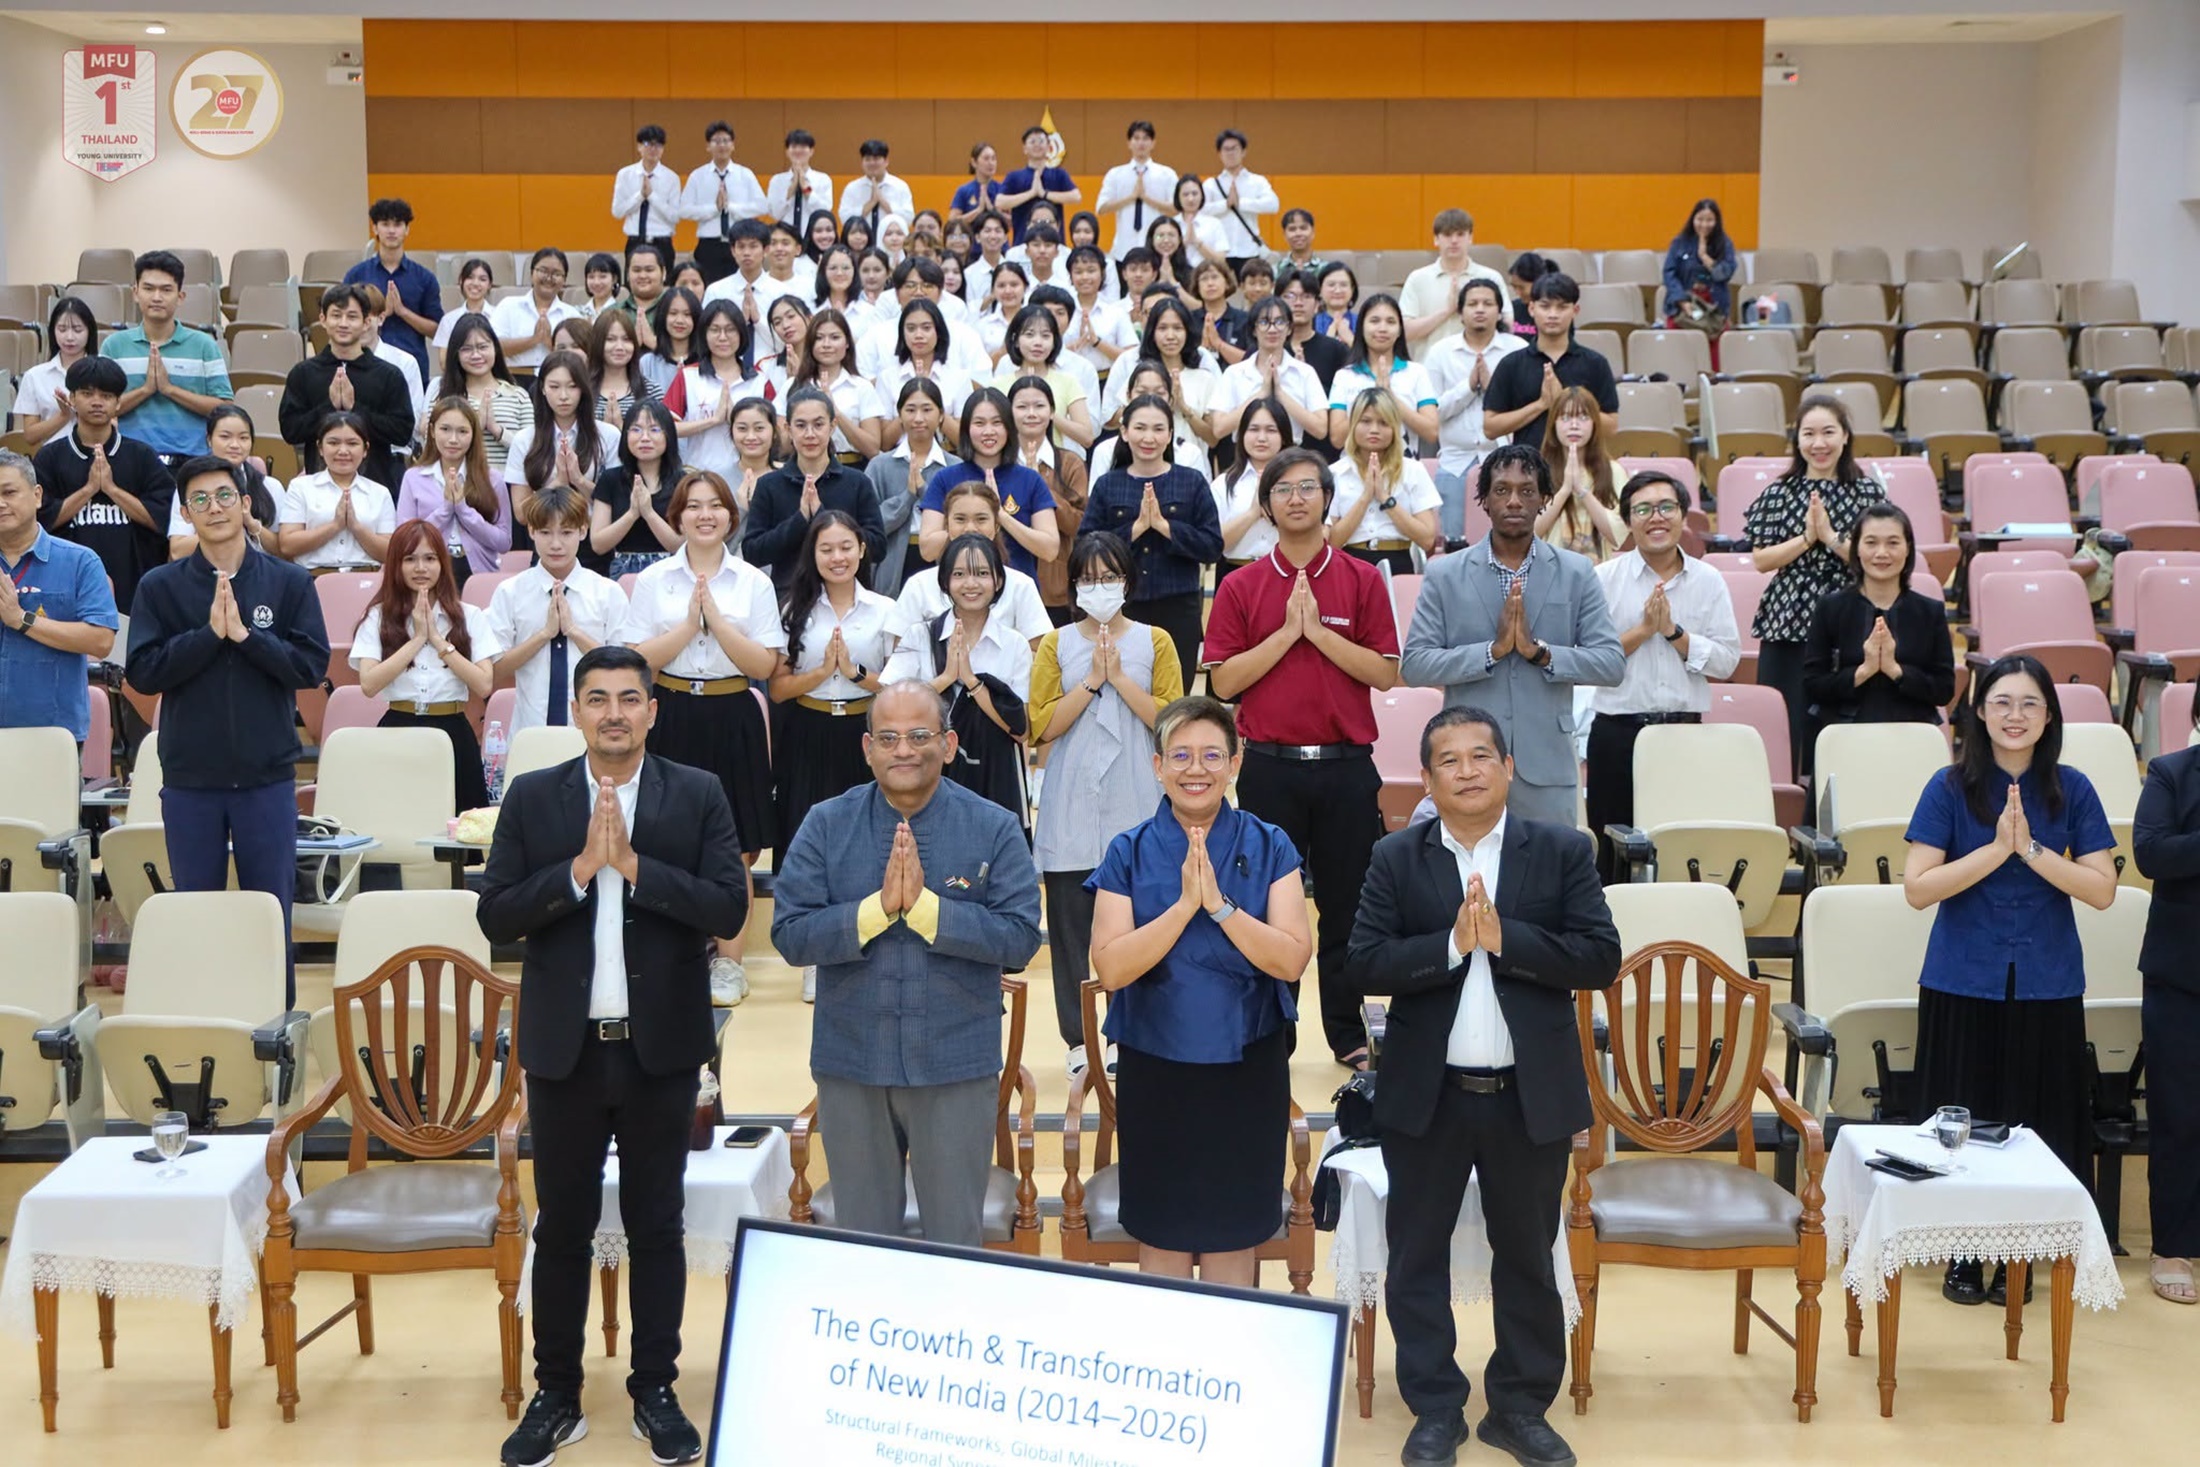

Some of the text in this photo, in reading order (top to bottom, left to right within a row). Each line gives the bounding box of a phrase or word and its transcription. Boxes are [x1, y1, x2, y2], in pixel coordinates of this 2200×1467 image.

[811, 1307, 1241, 1404] The Growth & Transformation
[825, 1408, 901, 1435] Structural
[905, 1422, 1005, 1455] Frameworks,
[1011, 1440, 1063, 1464] Global
[829, 1358, 1207, 1453] of New India (2014–2026)
[876, 1442, 943, 1467] Regional
